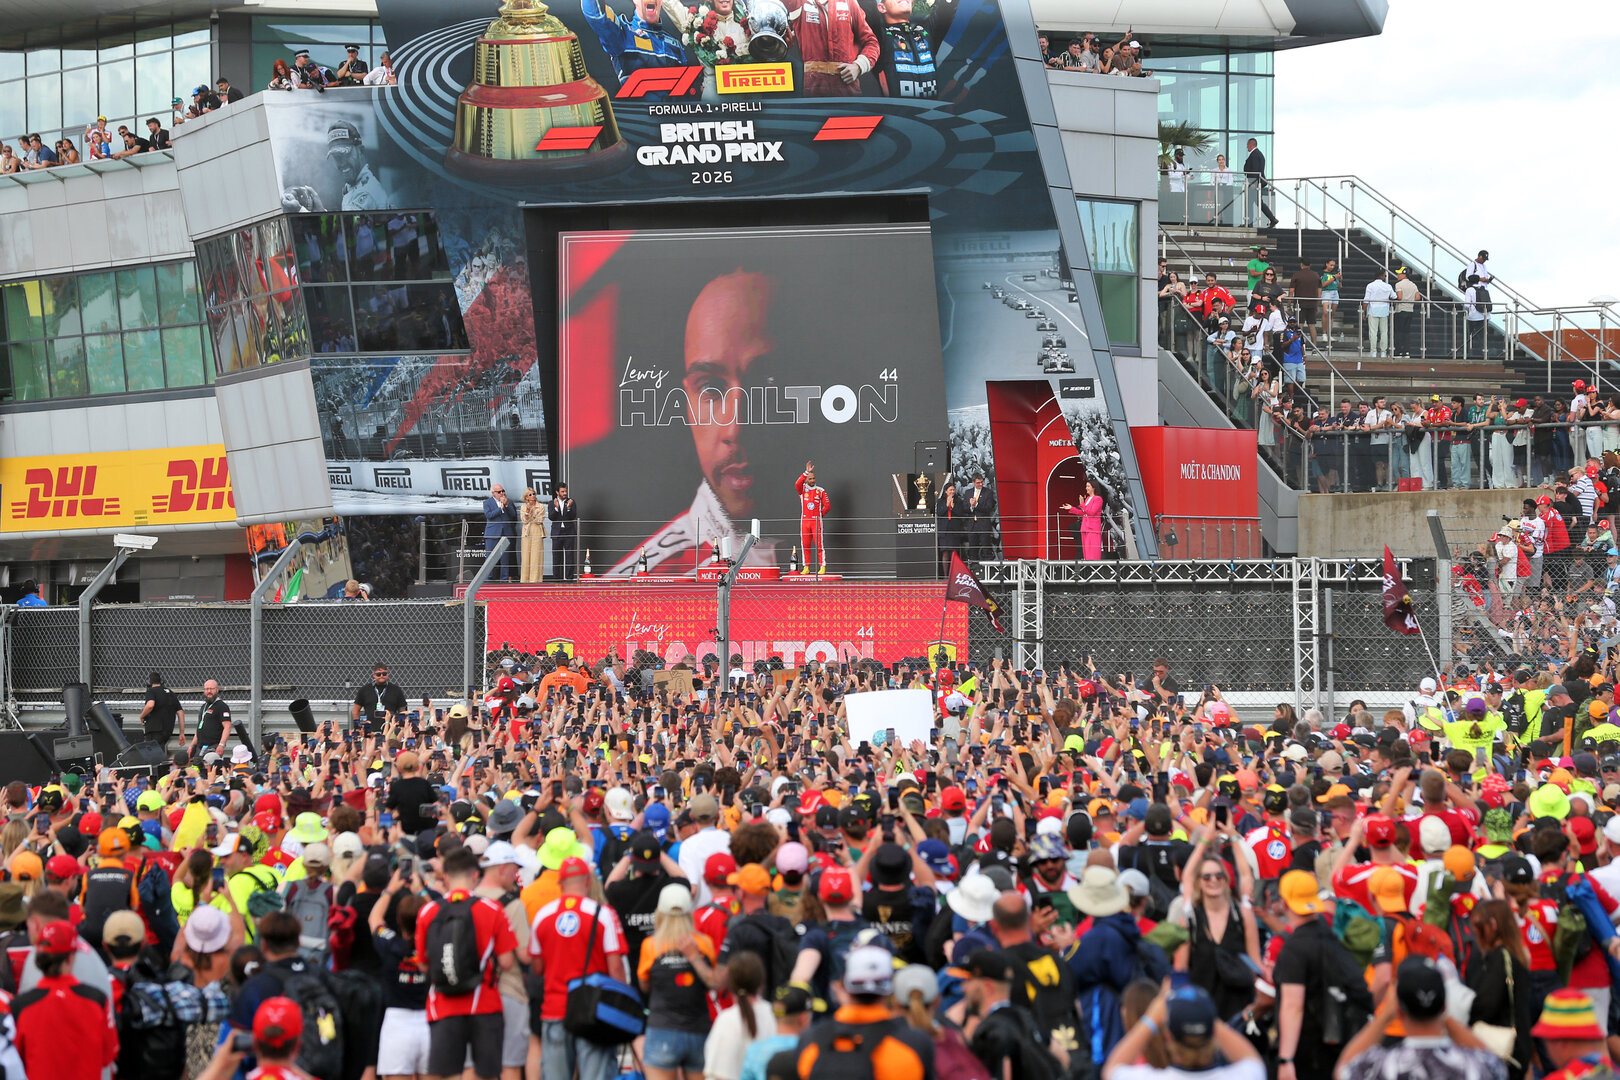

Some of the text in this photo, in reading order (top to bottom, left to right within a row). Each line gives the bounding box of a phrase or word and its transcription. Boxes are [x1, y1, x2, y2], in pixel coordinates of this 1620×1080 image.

[722, 69, 785, 88] PIRELLI
[649, 105, 702, 115] FORMULA
[722, 102, 762, 112] PIRELLI
[660, 120, 755, 143] BRITISH
[636, 141, 784, 166] GRAND PRIX
[692, 171, 733, 184] 2026
[618, 355, 670, 388] Lewis
[879, 368, 898, 382] 44
[620, 384, 898, 427] HAMILTON
[327, 467, 352, 485] RELLI
[374, 468, 412, 489] PIRELLI
[441, 467, 491, 491] PIRELLI
[1180, 460, 1241, 480] MOËT & CHANDON
[25, 465, 104, 518] DHL
[167, 456, 235, 512] DH
[701, 572, 718, 580] MOËT
[625, 612, 669, 640] Lewis
[857, 626, 874, 638] 44
